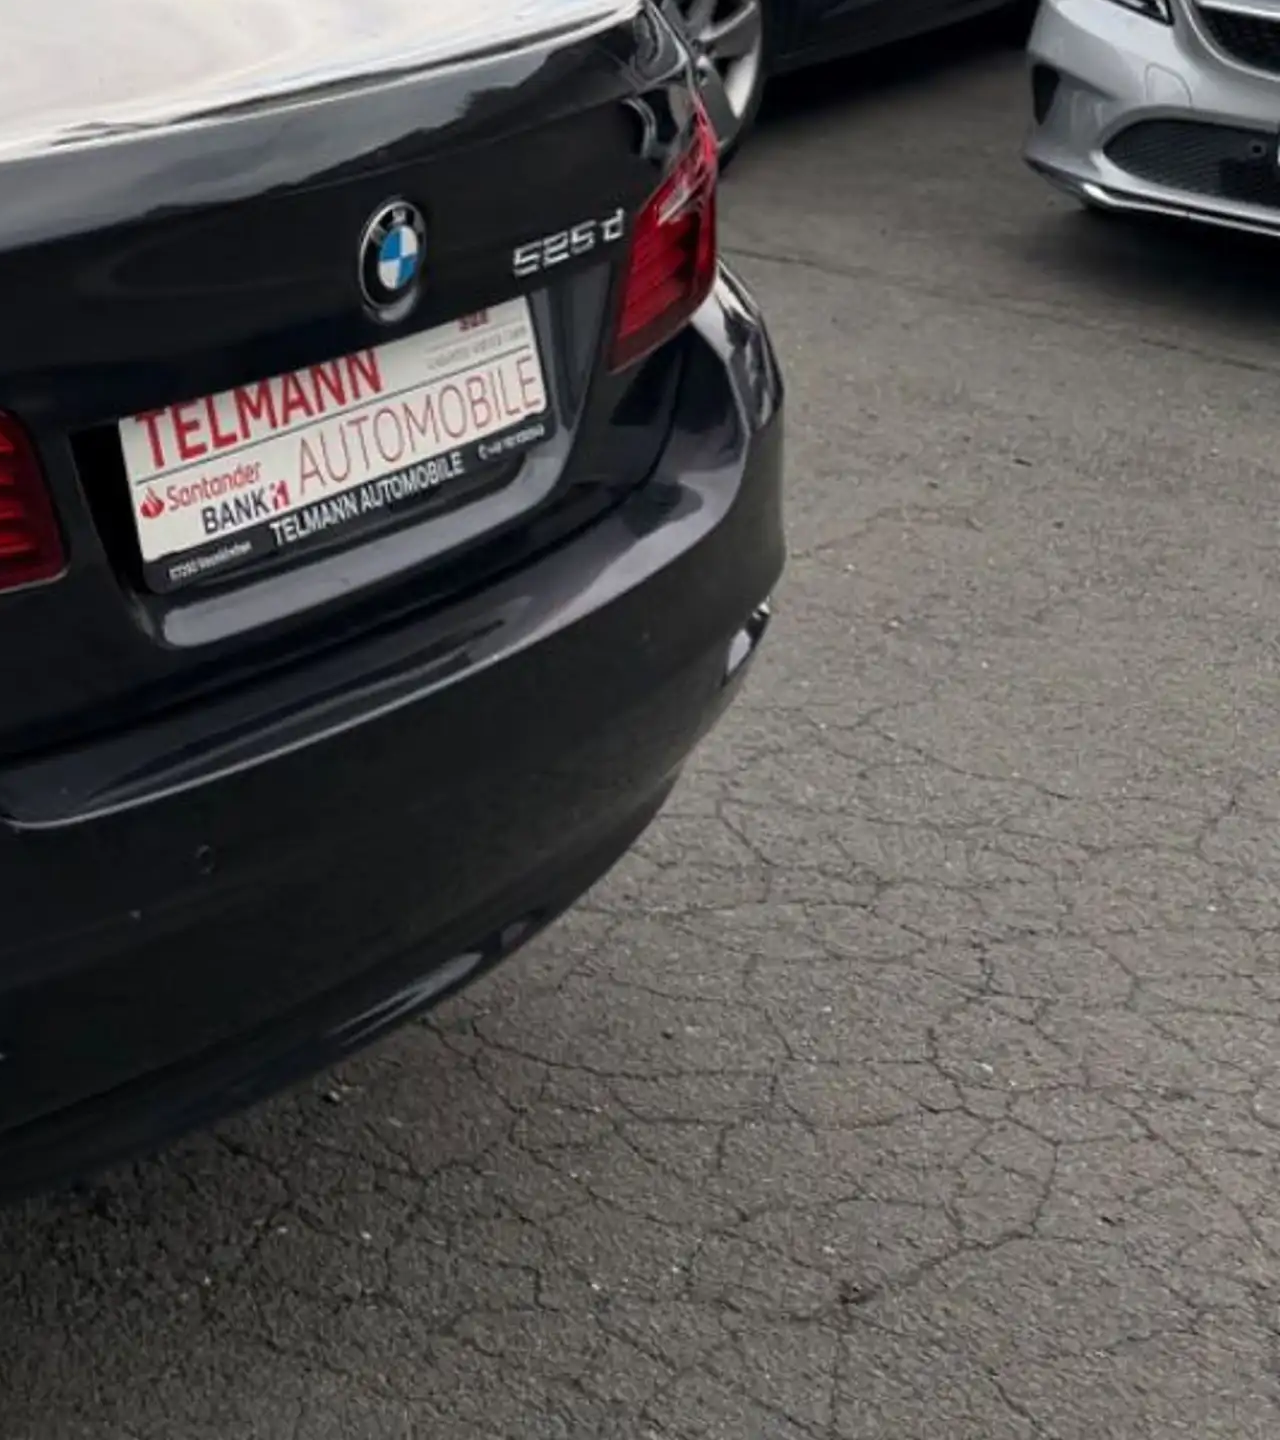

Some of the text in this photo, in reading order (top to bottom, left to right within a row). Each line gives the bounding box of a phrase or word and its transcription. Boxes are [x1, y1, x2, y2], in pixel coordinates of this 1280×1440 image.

[135, 348, 383, 468] TELMANN
[299, 354, 541, 496] AUTOMOBILE
[165, 461, 261, 511] Santander
[270, 451, 465, 546] TELMANN AUTOMOBILE
